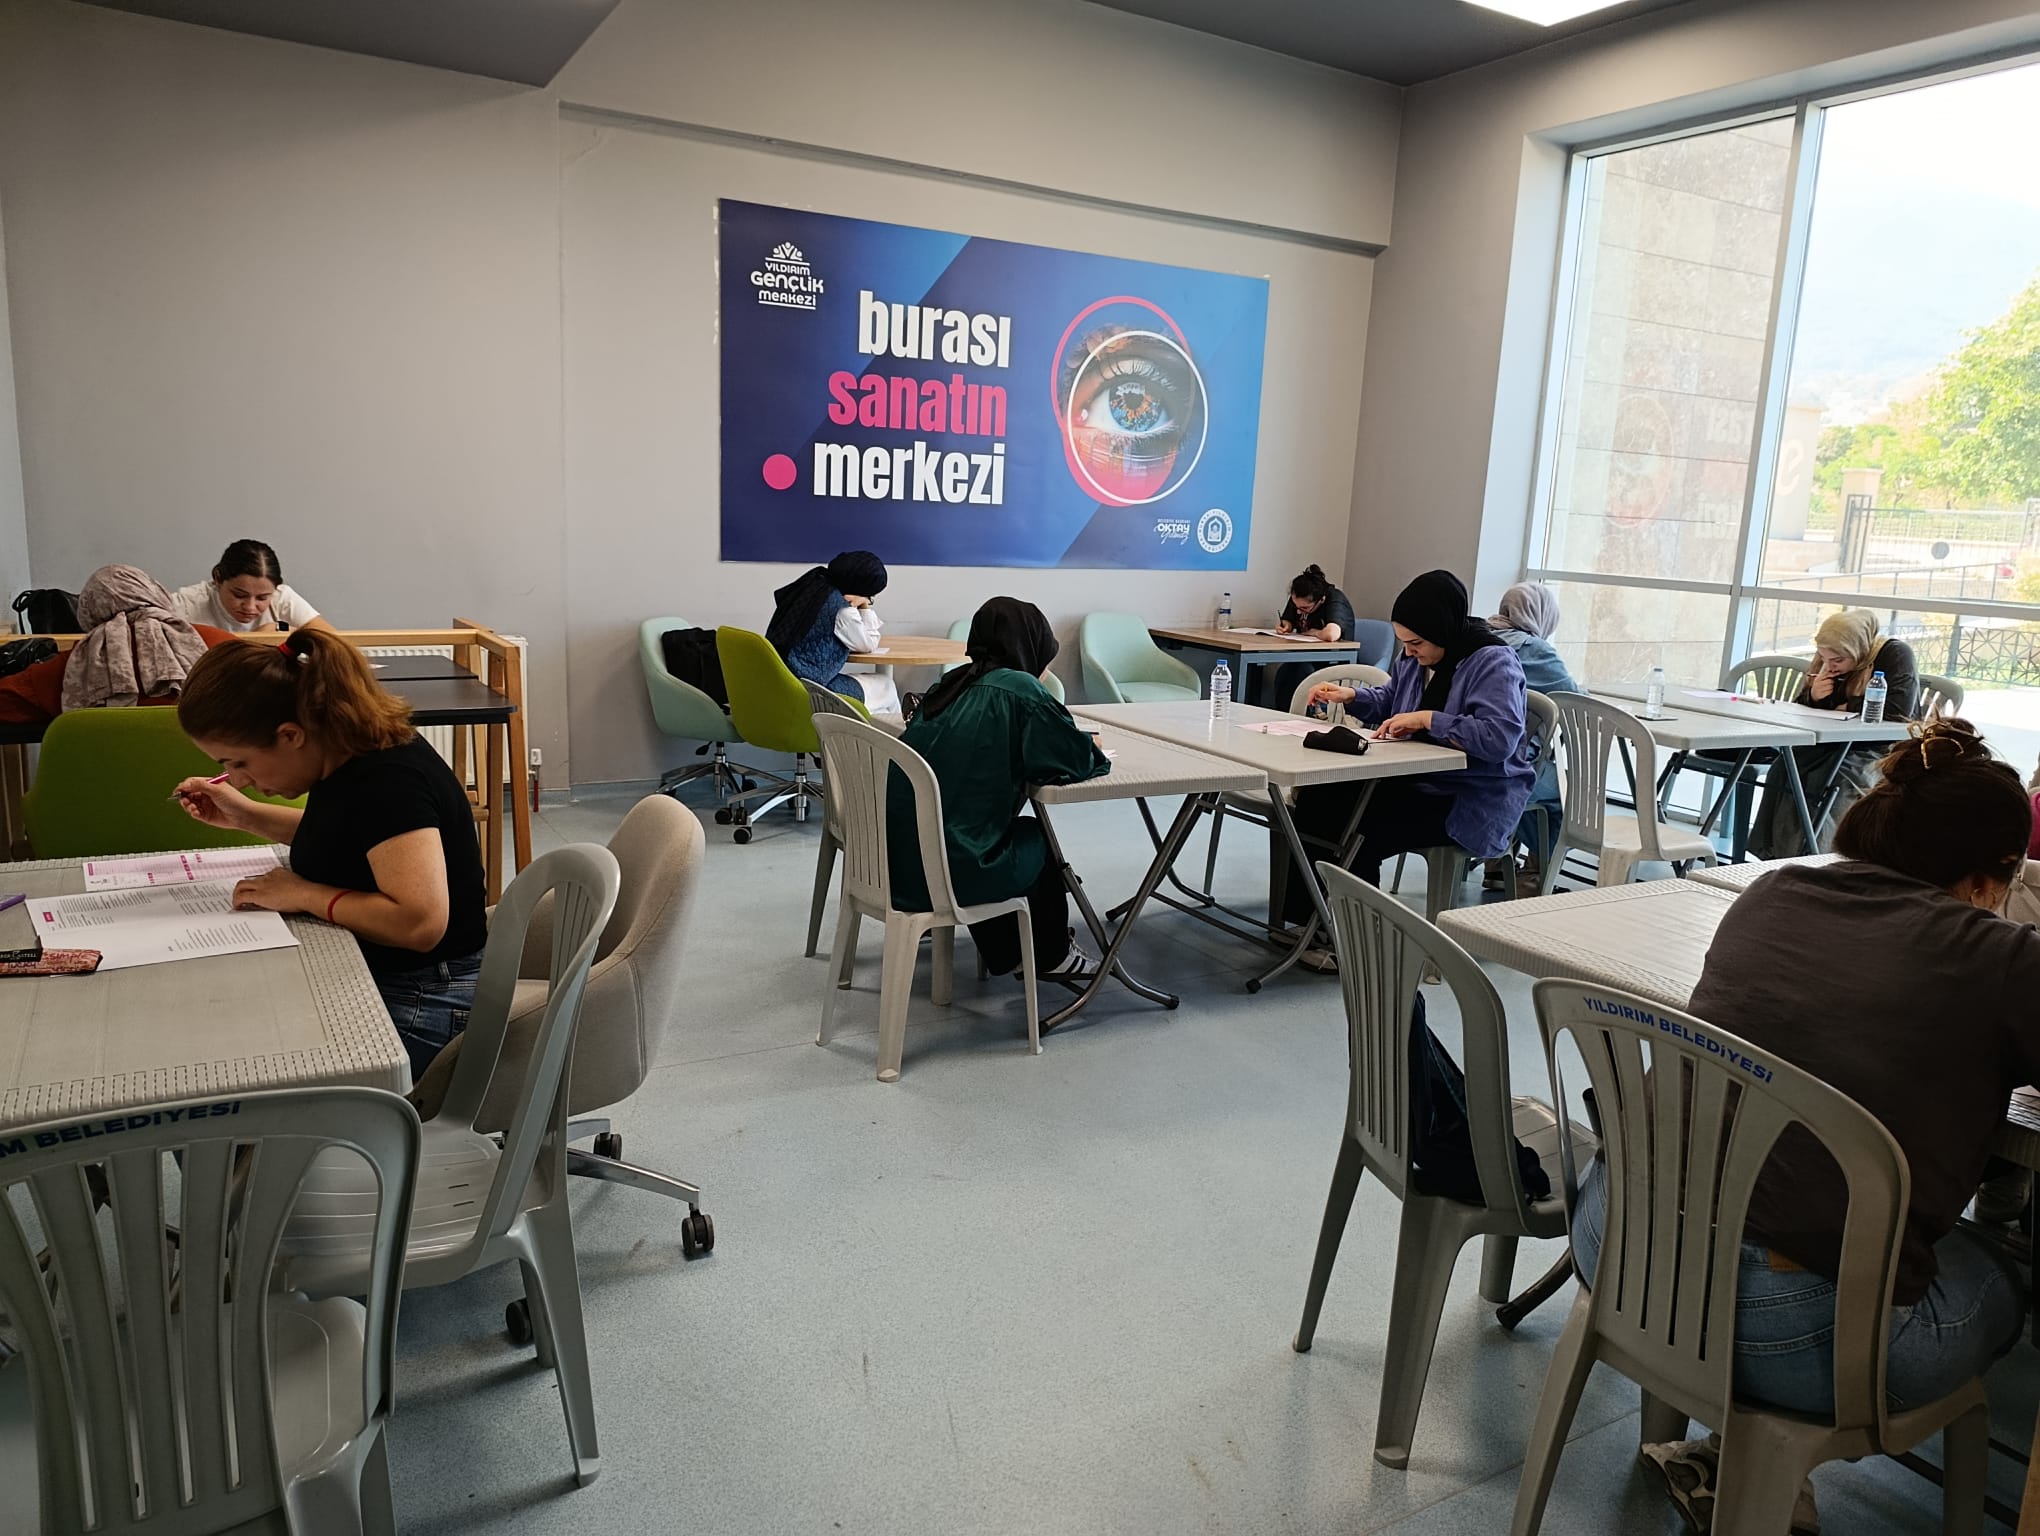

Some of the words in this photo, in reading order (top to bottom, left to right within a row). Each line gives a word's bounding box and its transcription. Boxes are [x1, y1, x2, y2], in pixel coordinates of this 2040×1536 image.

[858, 290, 1012, 368] burası
[827, 370, 1007, 438] sanatın
[813, 440, 1006, 505] merkezi
[1583, 996, 1655, 1027] YILDIRIM
[35, 1101, 241, 1150] BELEDİYESİ
